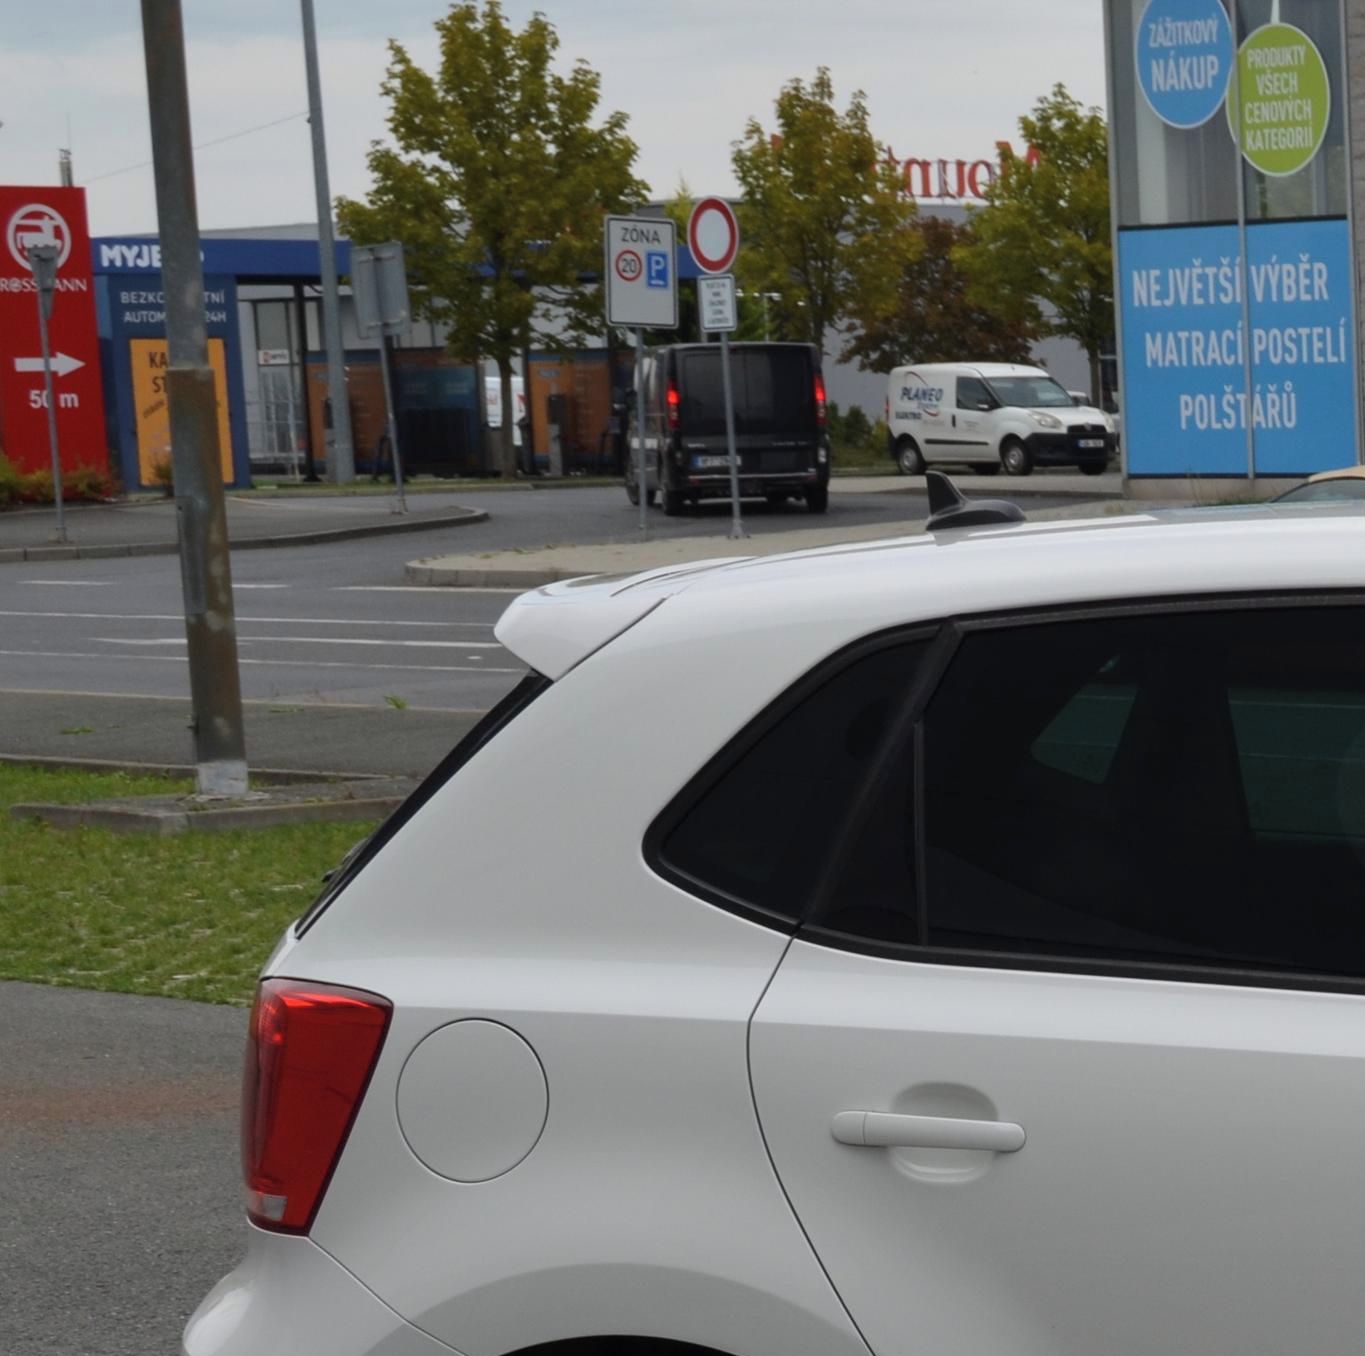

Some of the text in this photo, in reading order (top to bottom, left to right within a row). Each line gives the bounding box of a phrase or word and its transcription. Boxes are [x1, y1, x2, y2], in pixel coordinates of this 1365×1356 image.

[1148, 14, 1219, 47] ZÁŽITKOVÝ
[1247, 45, 1307, 69] PRODUKTY
[1151, 51, 1219, 92] NÁKUP
[1255, 70, 1298, 96] VŠECH
[1244, 96, 1313, 124] CENOVÝCH
[1245, 123, 1313, 150] KATEGORIÍ
[620, 225, 662, 244] ZÓNA
[621, 258, 637, 273] 20
[1132, 253, 1329, 307] NEJVĚTŠÍ VÝBĚR
[1145, 317, 1347, 368] MATRACÍ POSTELÍ
[59, 393, 79, 408] m
[901, 386, 944, 402] PLANEO
[1179, 380, 1297, 430] POLŠTÁŘŮ
